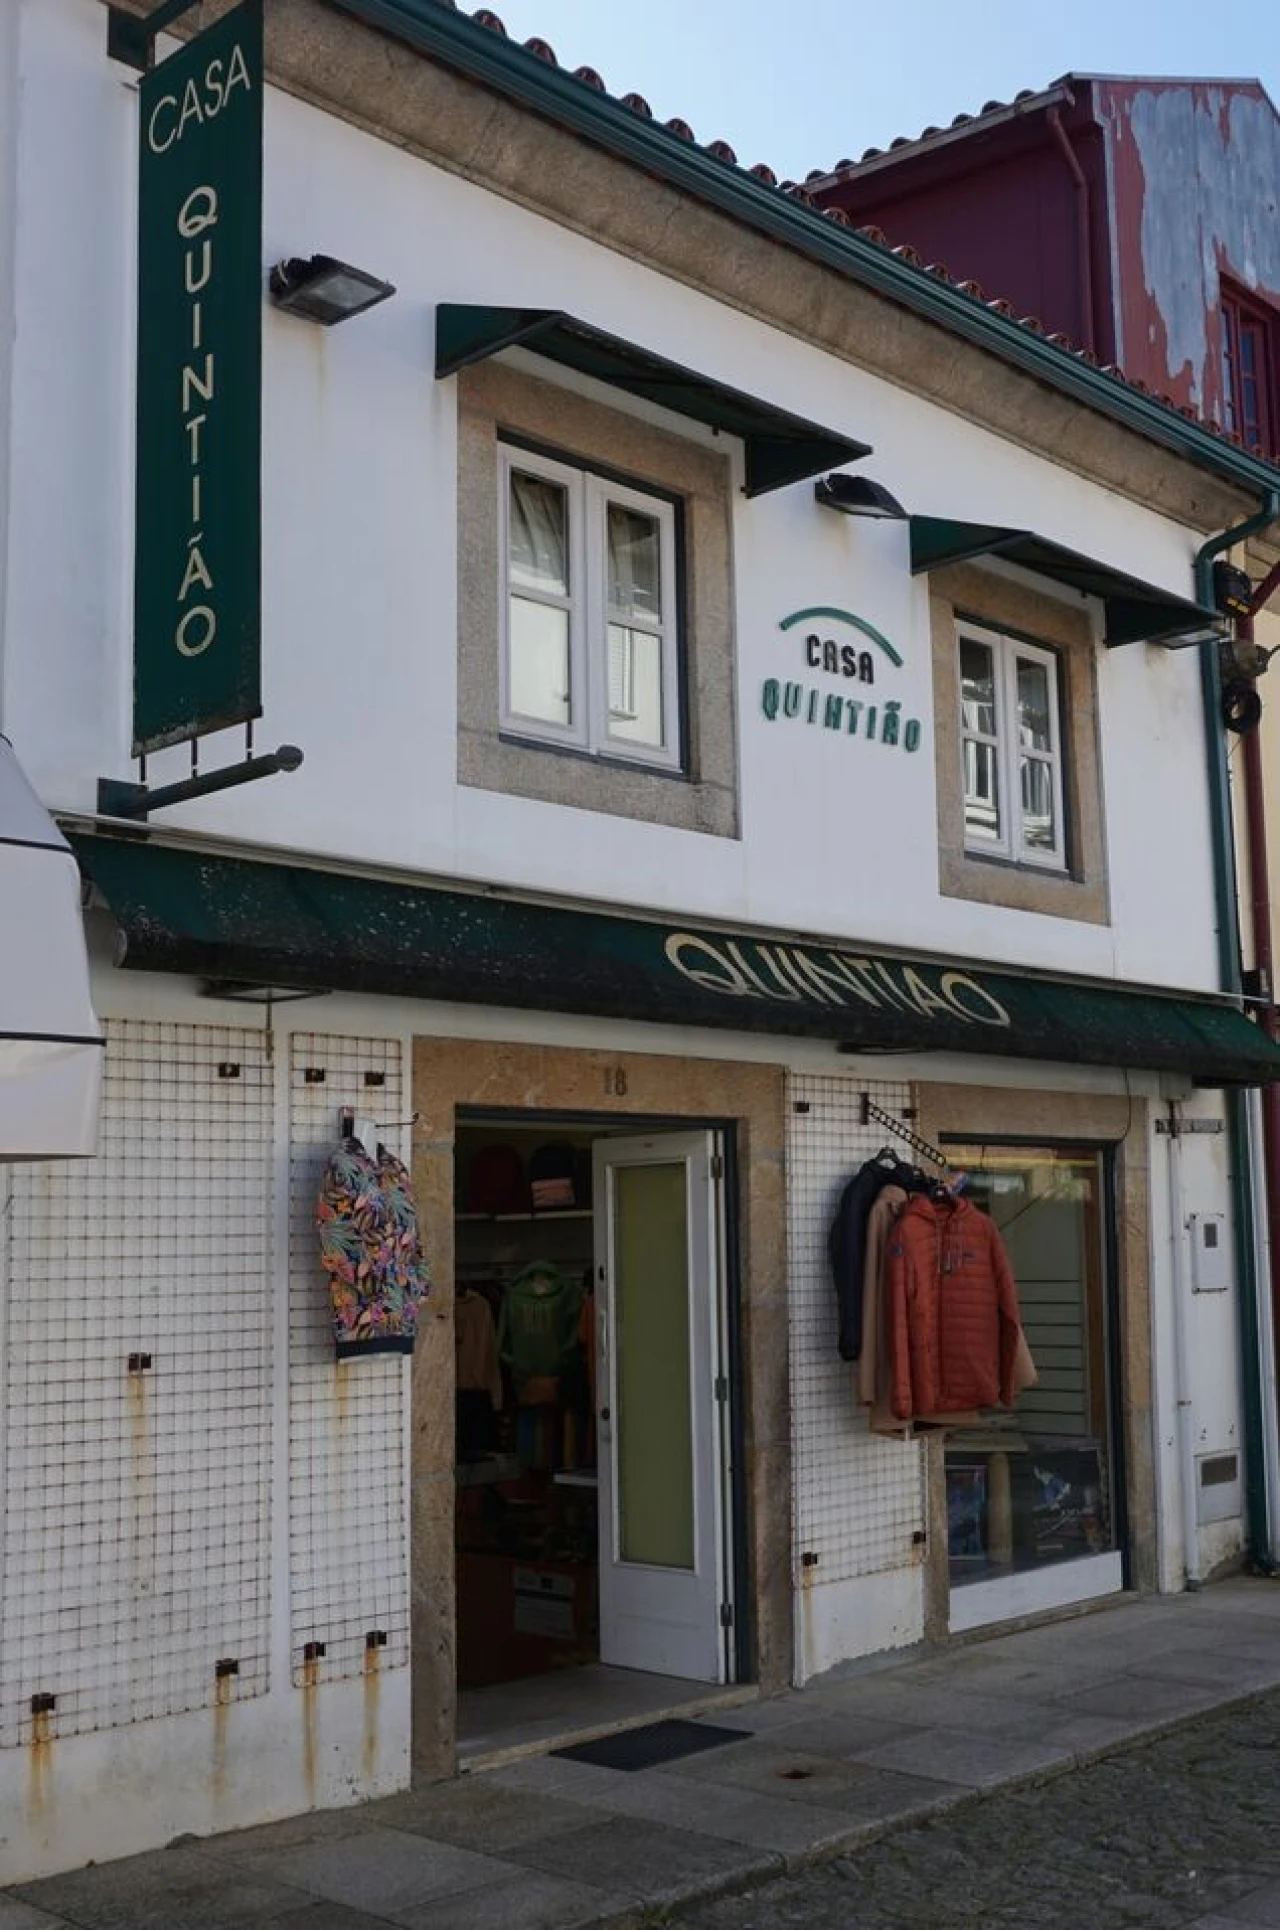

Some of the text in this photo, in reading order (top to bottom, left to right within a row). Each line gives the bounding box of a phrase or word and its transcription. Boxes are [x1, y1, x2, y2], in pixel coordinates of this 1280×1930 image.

[149, 44, 251, 153] CASA
[175, 186, 219, 657] QUINTIÃO
[806, 633, 875, 685] CASA
[762, 677, 921, 753] QUINTIÃO
[603, 1066, 629, 1096] 18
